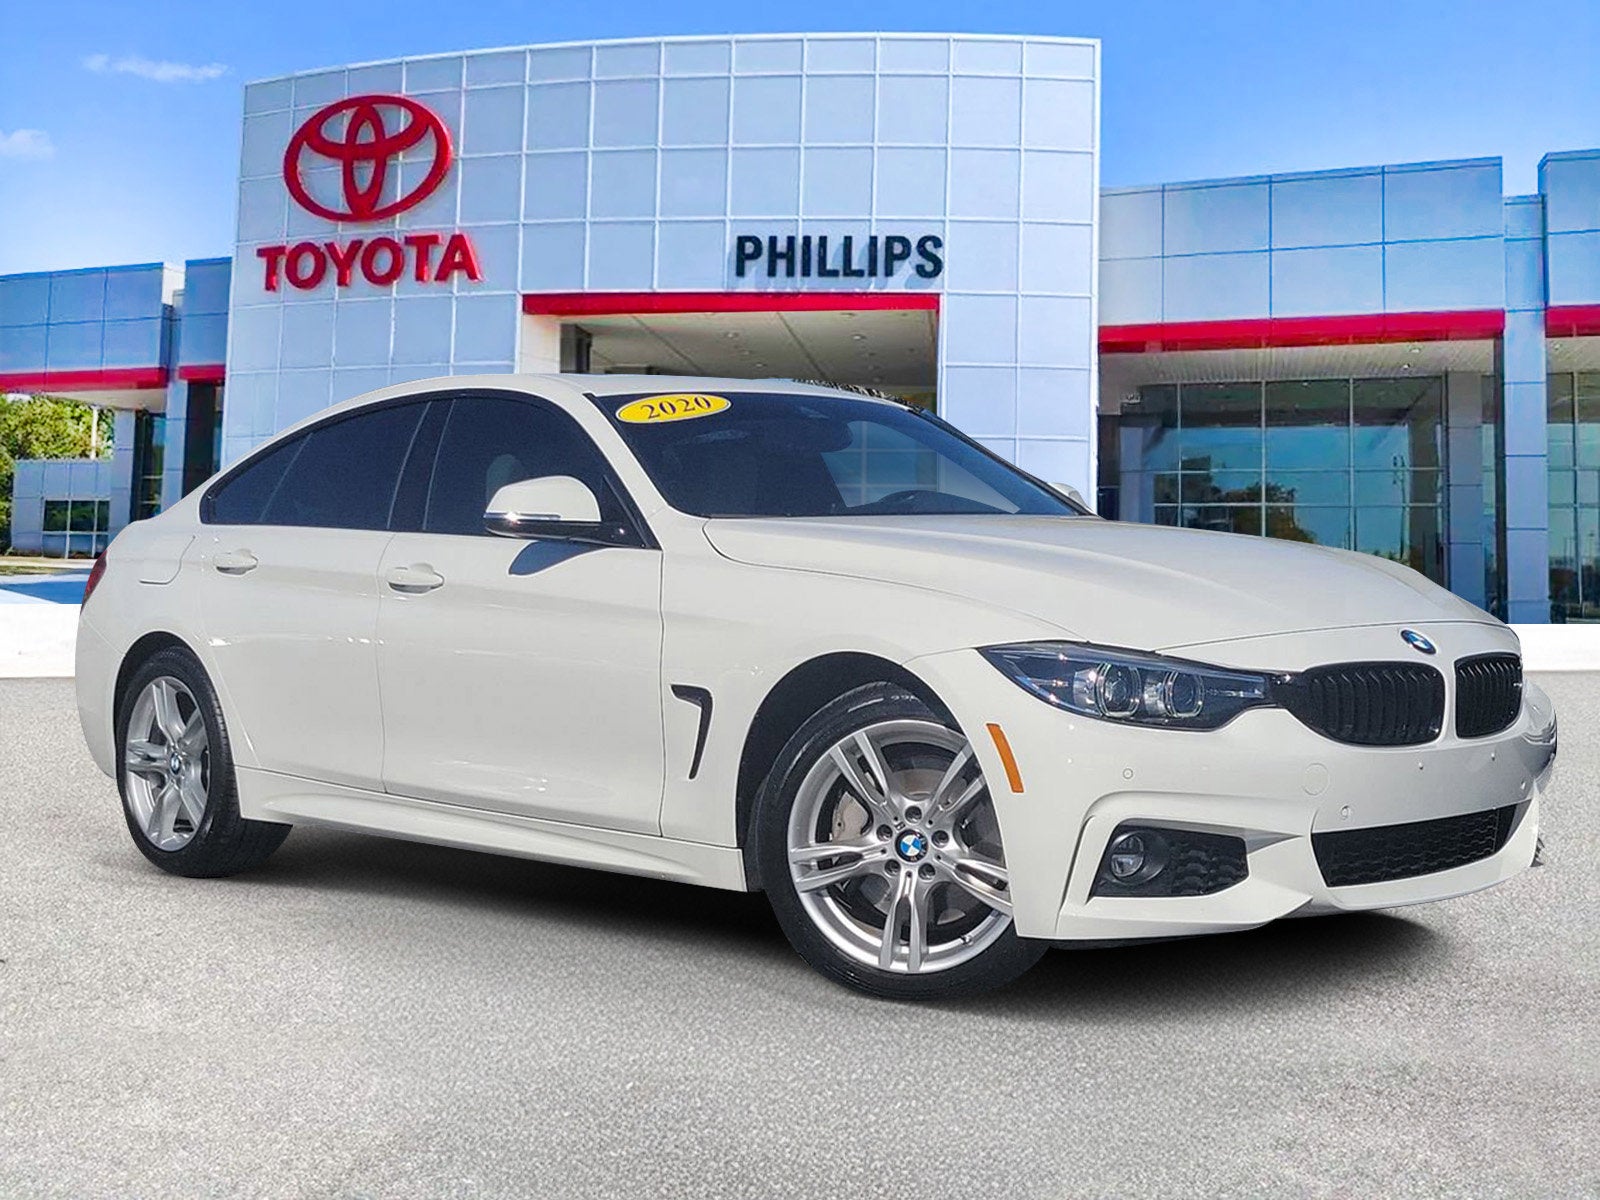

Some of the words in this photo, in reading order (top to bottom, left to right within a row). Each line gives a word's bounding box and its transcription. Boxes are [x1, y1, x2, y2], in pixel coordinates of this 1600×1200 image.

[257, 233, 482, 291] TOYOTA
[735, 235, 943, 278] PHILLIPS
[640, 396, 711, 419] 2020
